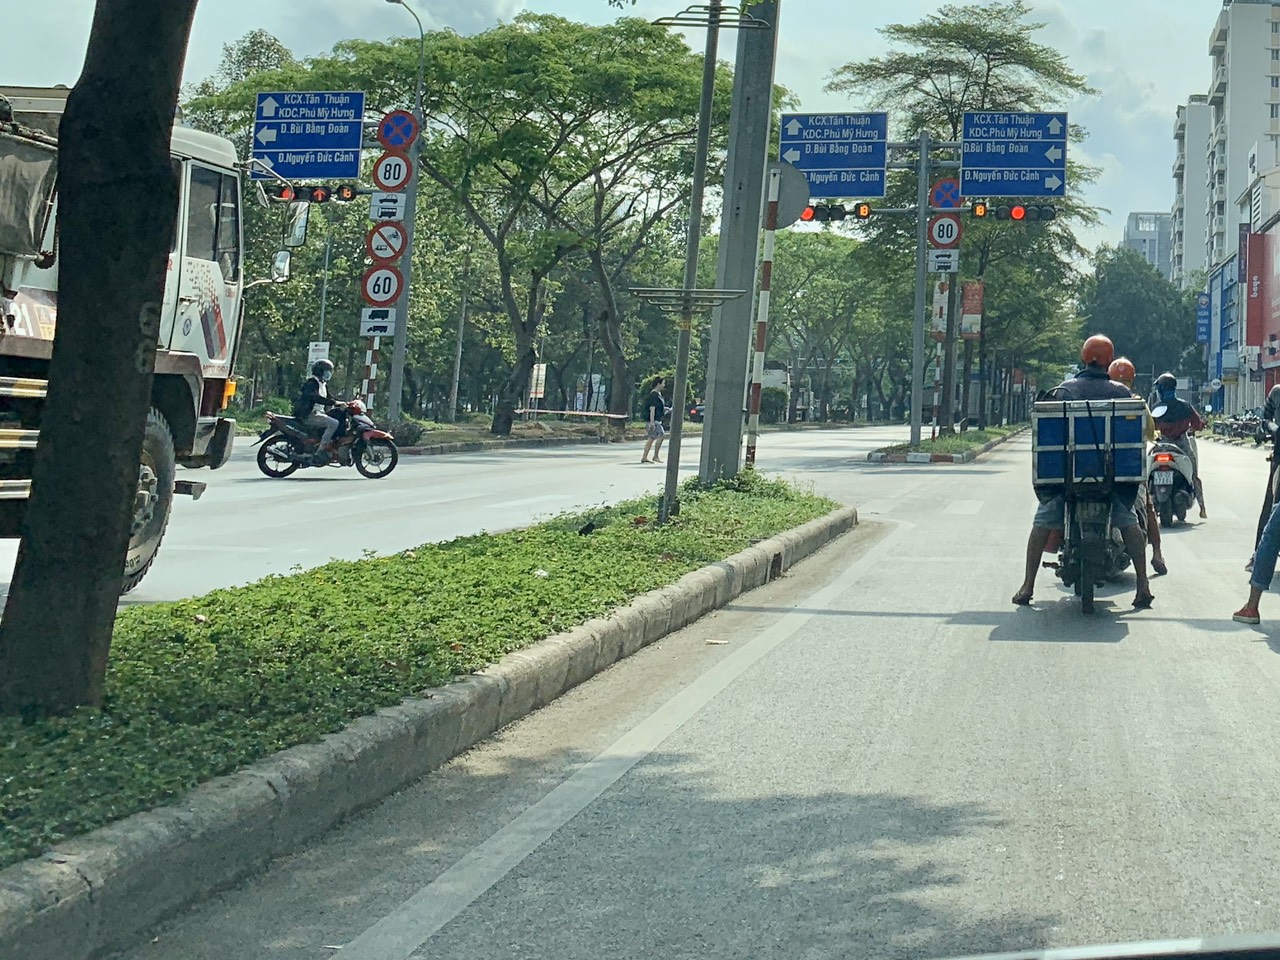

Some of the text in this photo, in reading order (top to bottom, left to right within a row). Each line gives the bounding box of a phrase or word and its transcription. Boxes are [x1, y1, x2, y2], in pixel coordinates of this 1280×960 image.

[324, 93, 350, 106] Thuận
[331, 108, 355, 120] Hưng
[846, 115, 871, 128] Thuận
[1010, 114, 1035, 127] Thuận
[855, 129, 879, 140] Hưng
[1020, 128, 1043, 140] Hưng
[317, 152, 333, 163] Đức
[334, 151, 354, 162] Cảnh
[383, 163, 401, 181] 80
[841, 171, 857, 182] Đức
[860, 171, 880, 182] Cảnh
[1003, 170, 1019, 181] Đức
[1020, 169, 1040, 181] Cảnh
[937, 223, 954, 239] 80
[372, 276, 391, 295] 60
